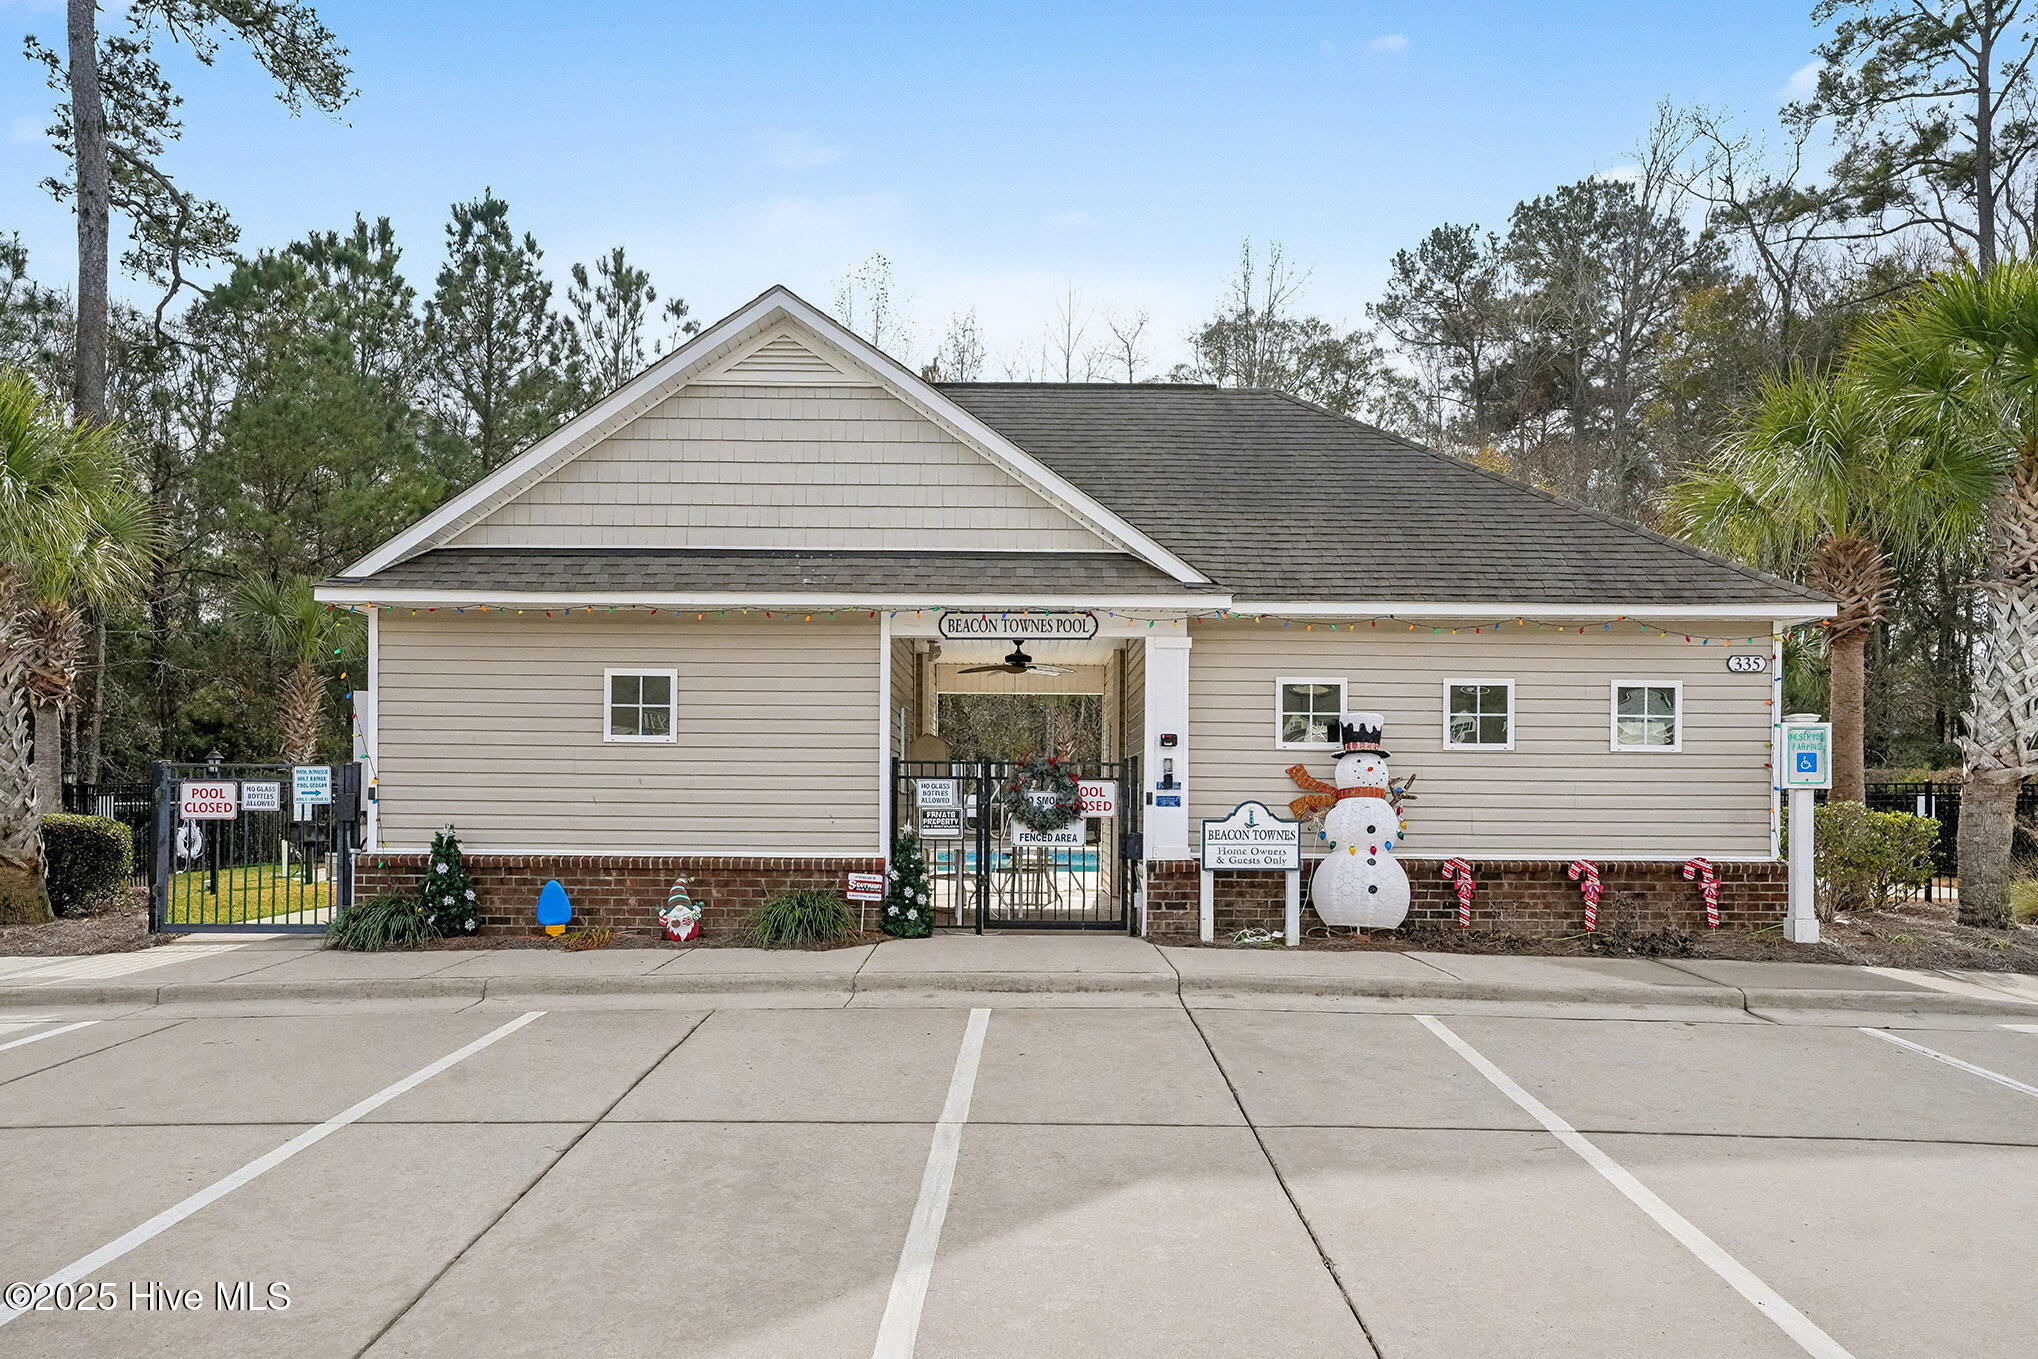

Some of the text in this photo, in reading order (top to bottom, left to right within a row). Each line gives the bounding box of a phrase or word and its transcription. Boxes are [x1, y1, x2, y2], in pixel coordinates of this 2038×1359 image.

[948, 618, 1090, 633] BEACON TOWNES POOL
[1734, 657, 1760, 671] 335
[192, 788, 226, 799] POOL
[1080, 787, 1106, 798] OOL
[184, 802, 233, 813] CLOSED
[1019, 833, 1078, 843] FENCED AREA
[1208, 830, 1296, 840] BEACON TOWNES
[1218, 847, 1287, 856] Home Owners
[1216, 856, 1287, 866] & Guests Only
